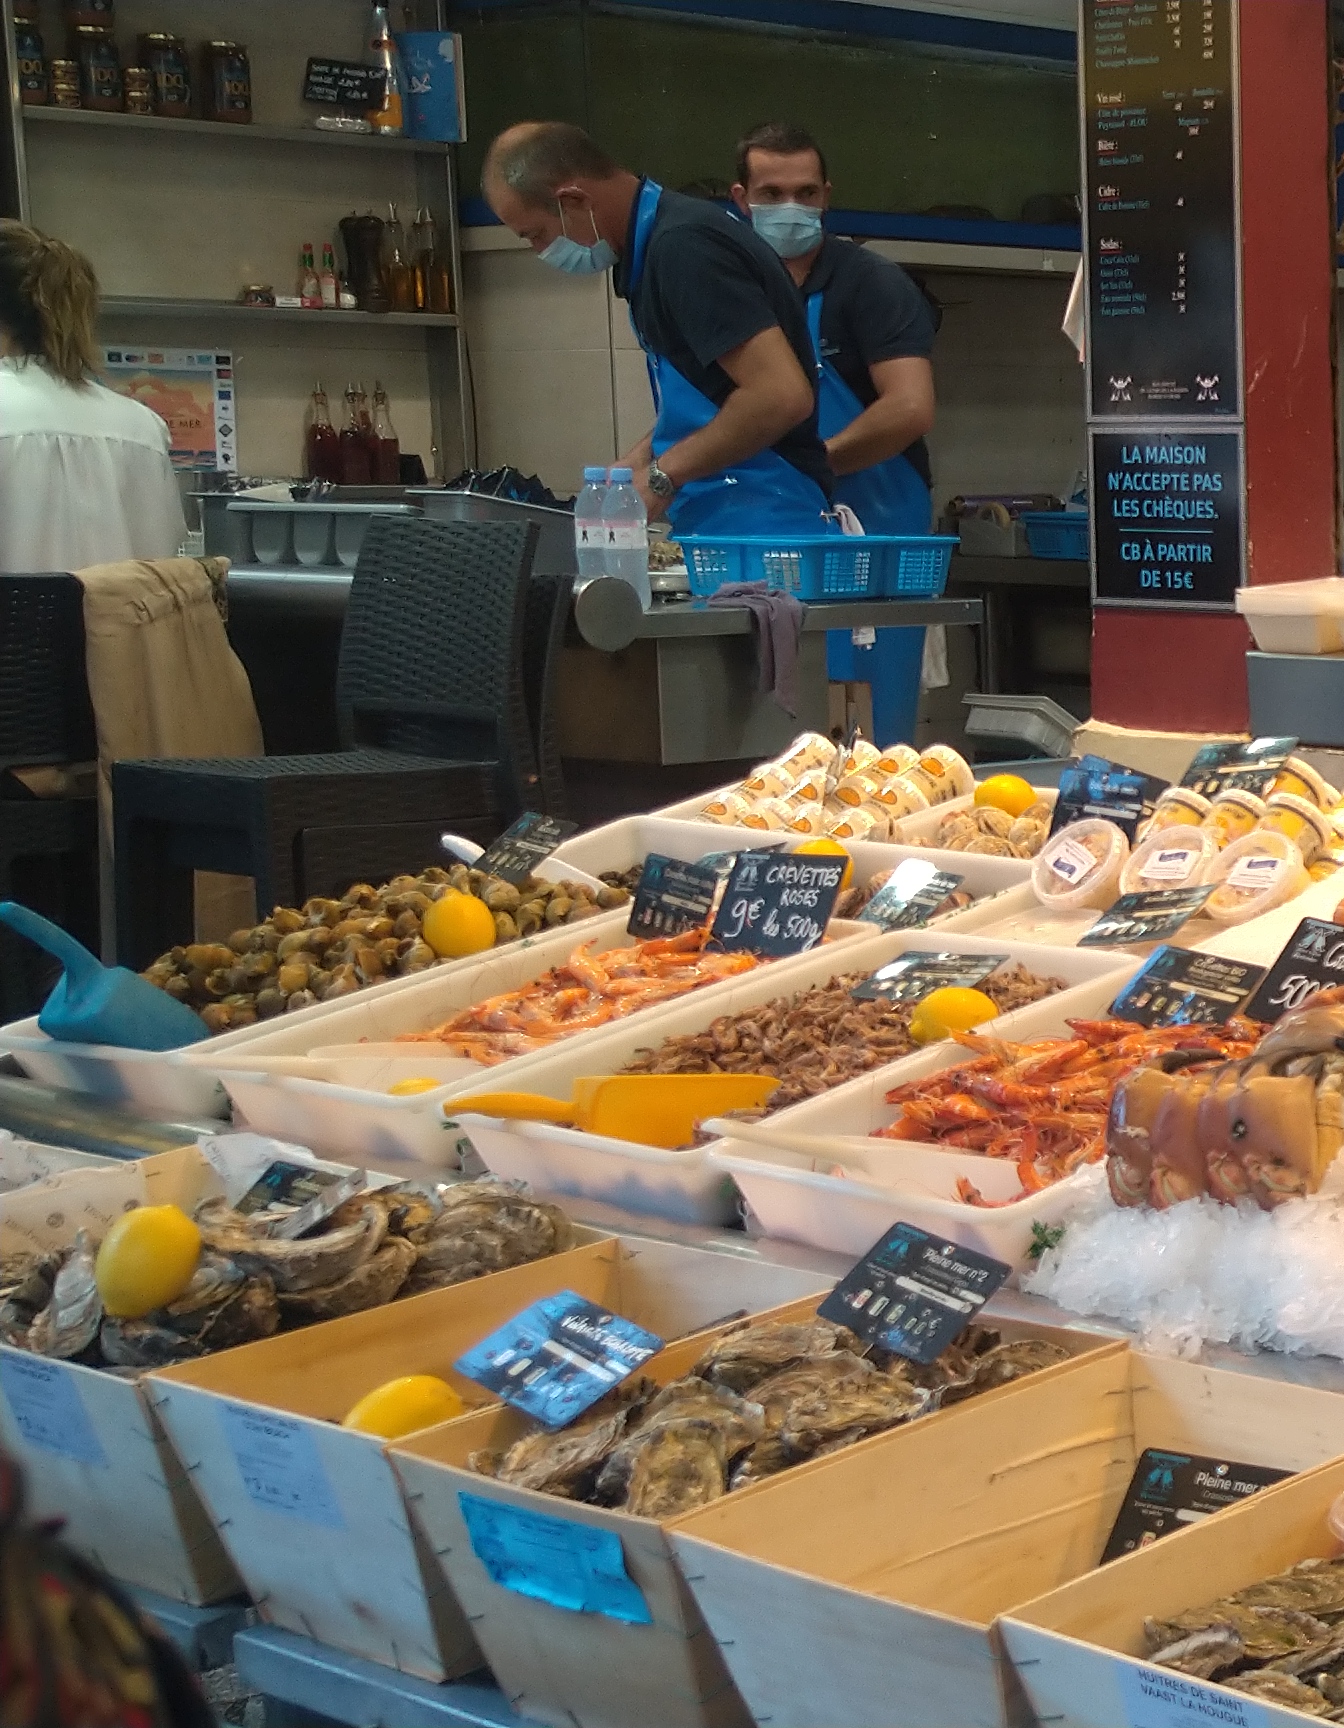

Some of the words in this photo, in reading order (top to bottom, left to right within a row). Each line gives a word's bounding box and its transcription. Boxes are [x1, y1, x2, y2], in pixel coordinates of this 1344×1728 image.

[1121, 446, 1142, 464] LA
[1145, 445, 1206, 465] MAISON
[1107, 472, 1190, 492] N'ACCEPTE
[1193, 473, 1223, 492] PAS
[1113, 499, 1139, 518] LES
[1143, 496, 1220, 521] CHÈQUES.
[1121, 542, 1141, 562] CB
[1143, 538, 1155, 561] À
[1158, 543, 1213, 563] PARTIR
[1140, 570, 1161, 588] DE
[1166, 571, 1194, 589] 15€
[766, 864, 842, 888] CREVETTES
[780, 888, 821, 908] ROSES
[1195, 1471, 1232, 1490] Pleine
[1233, 1482, 1258, 1494] mer
[1138, 1669, 1189, 1694] HUITRES
[1190, 1686, 1208, 1701] DE
[1209, 1693, 1244, 1713] SAINT
[1140, 1683, 1177, 1705] VAAST
[1180, 1697, 1197, 1711] LA
